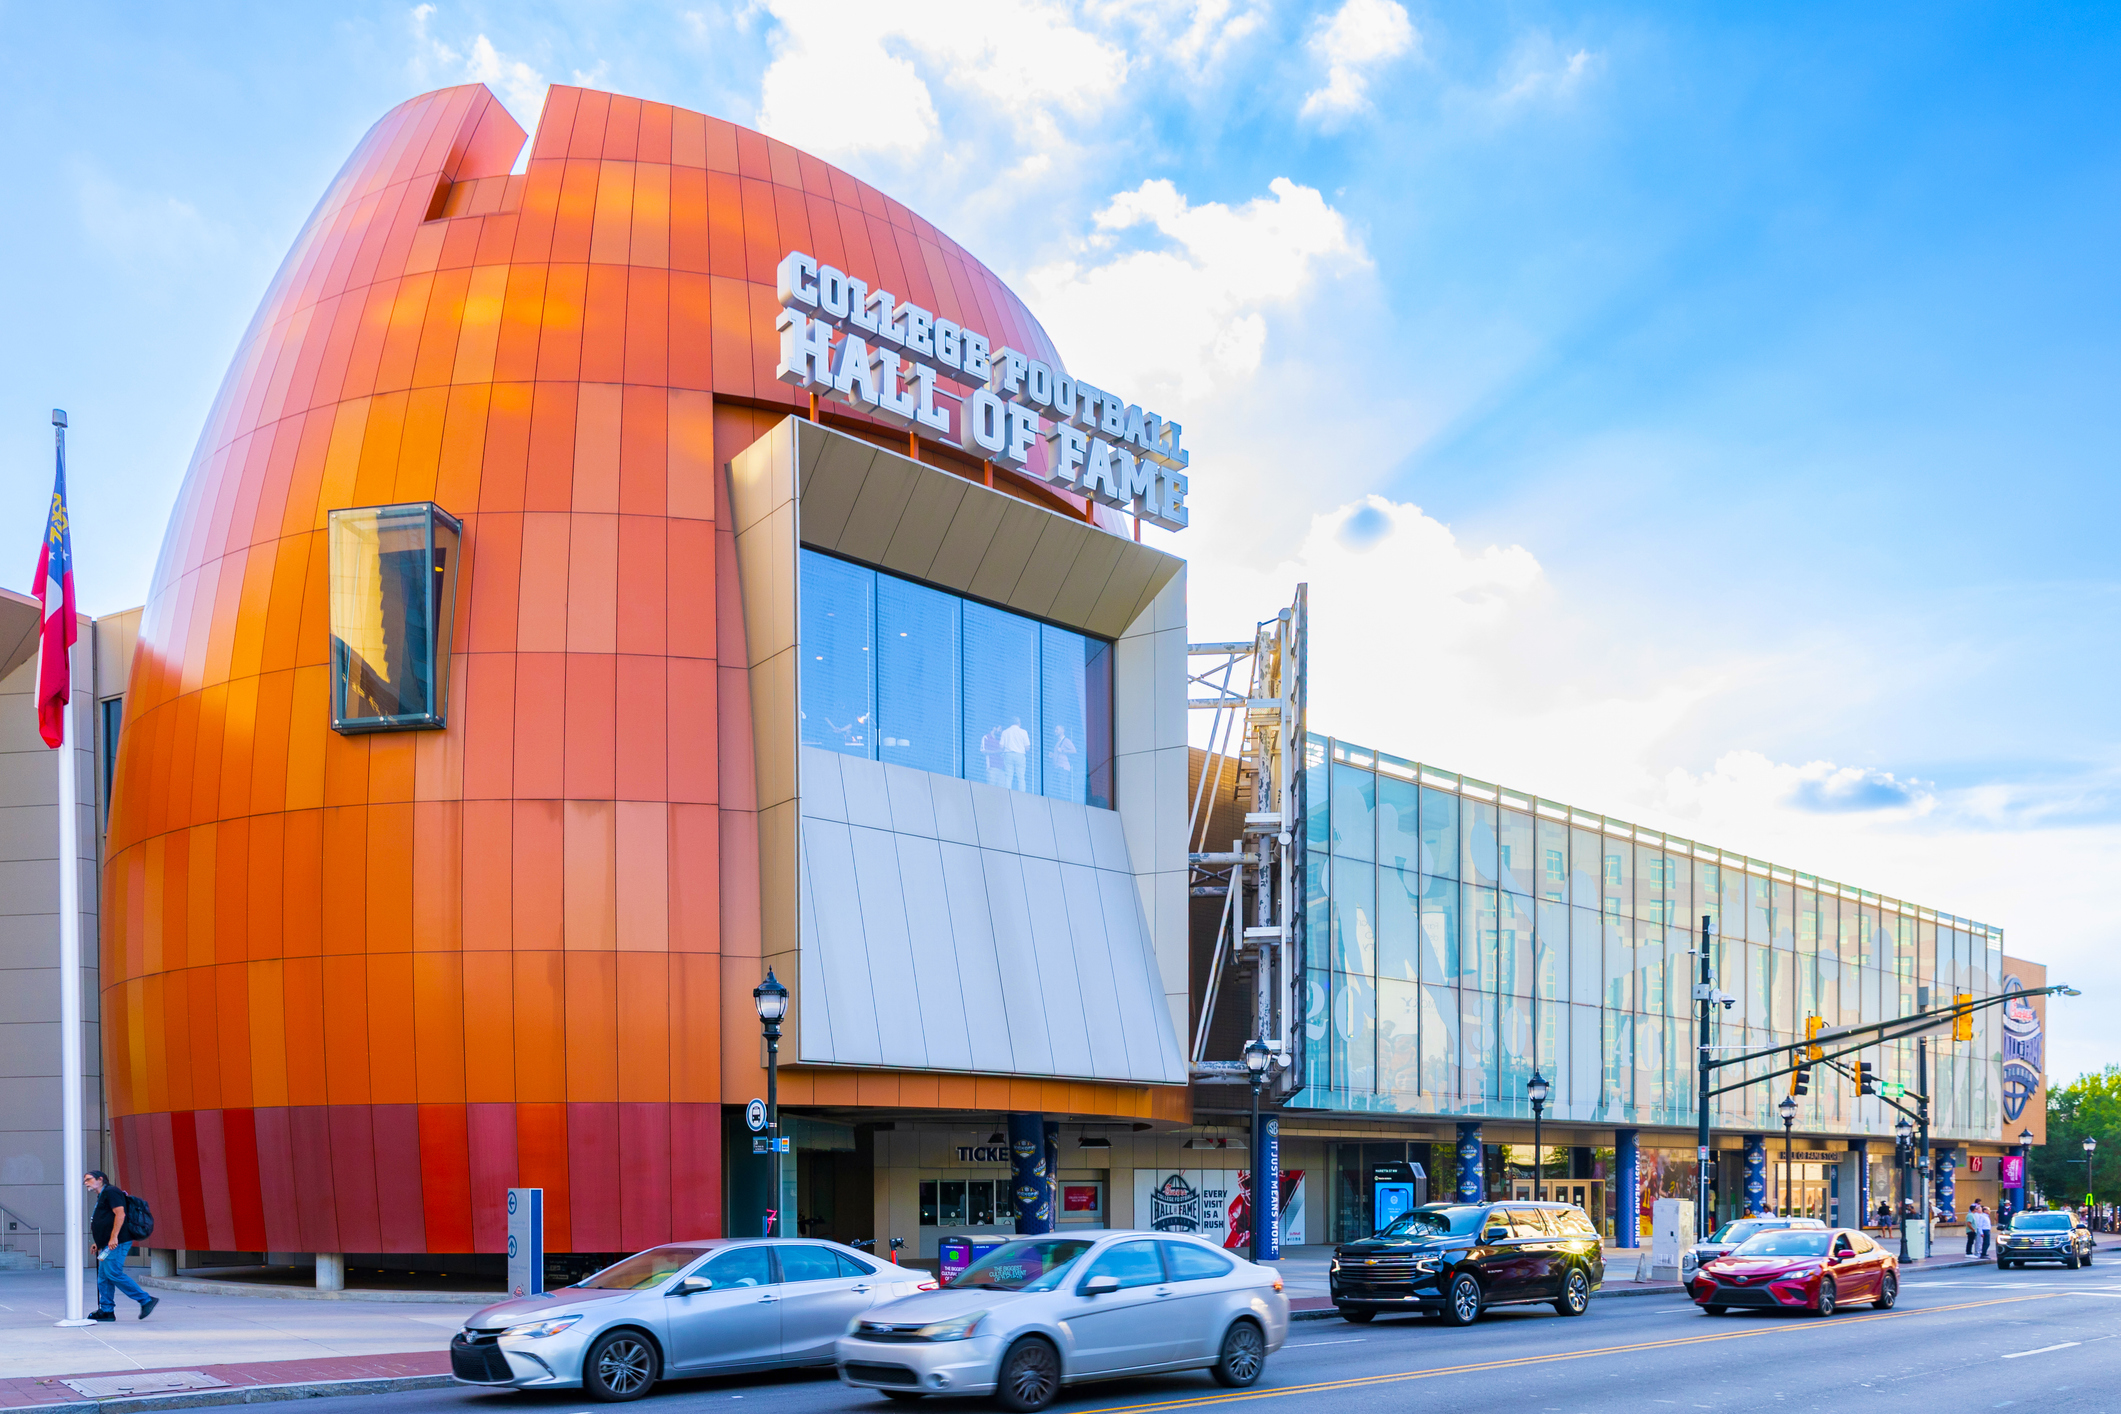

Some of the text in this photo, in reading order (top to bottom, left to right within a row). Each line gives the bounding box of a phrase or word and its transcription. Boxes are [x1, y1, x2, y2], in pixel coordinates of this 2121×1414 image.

[779, 251, 1188, 469] COLLEGE FOOTBALL
[777, 308, 1188, 531] HALL OF FAME
[1471, 999, 1527, 1058] 30
[956, 1146, 1009, 1161] TICKE
[1203, 1190, 1228, 1198] EVERY
[1203, 1200, 1223, 1208] VISIT
[1270, 1141, 1279, 1255] IT JUST MEANS MORE.
[1154, 1201, 1173, 1220] HALL
[1179, 1200, 1197, 1219] FAME
[1203, 1221, 1224, 1229] RUSH
